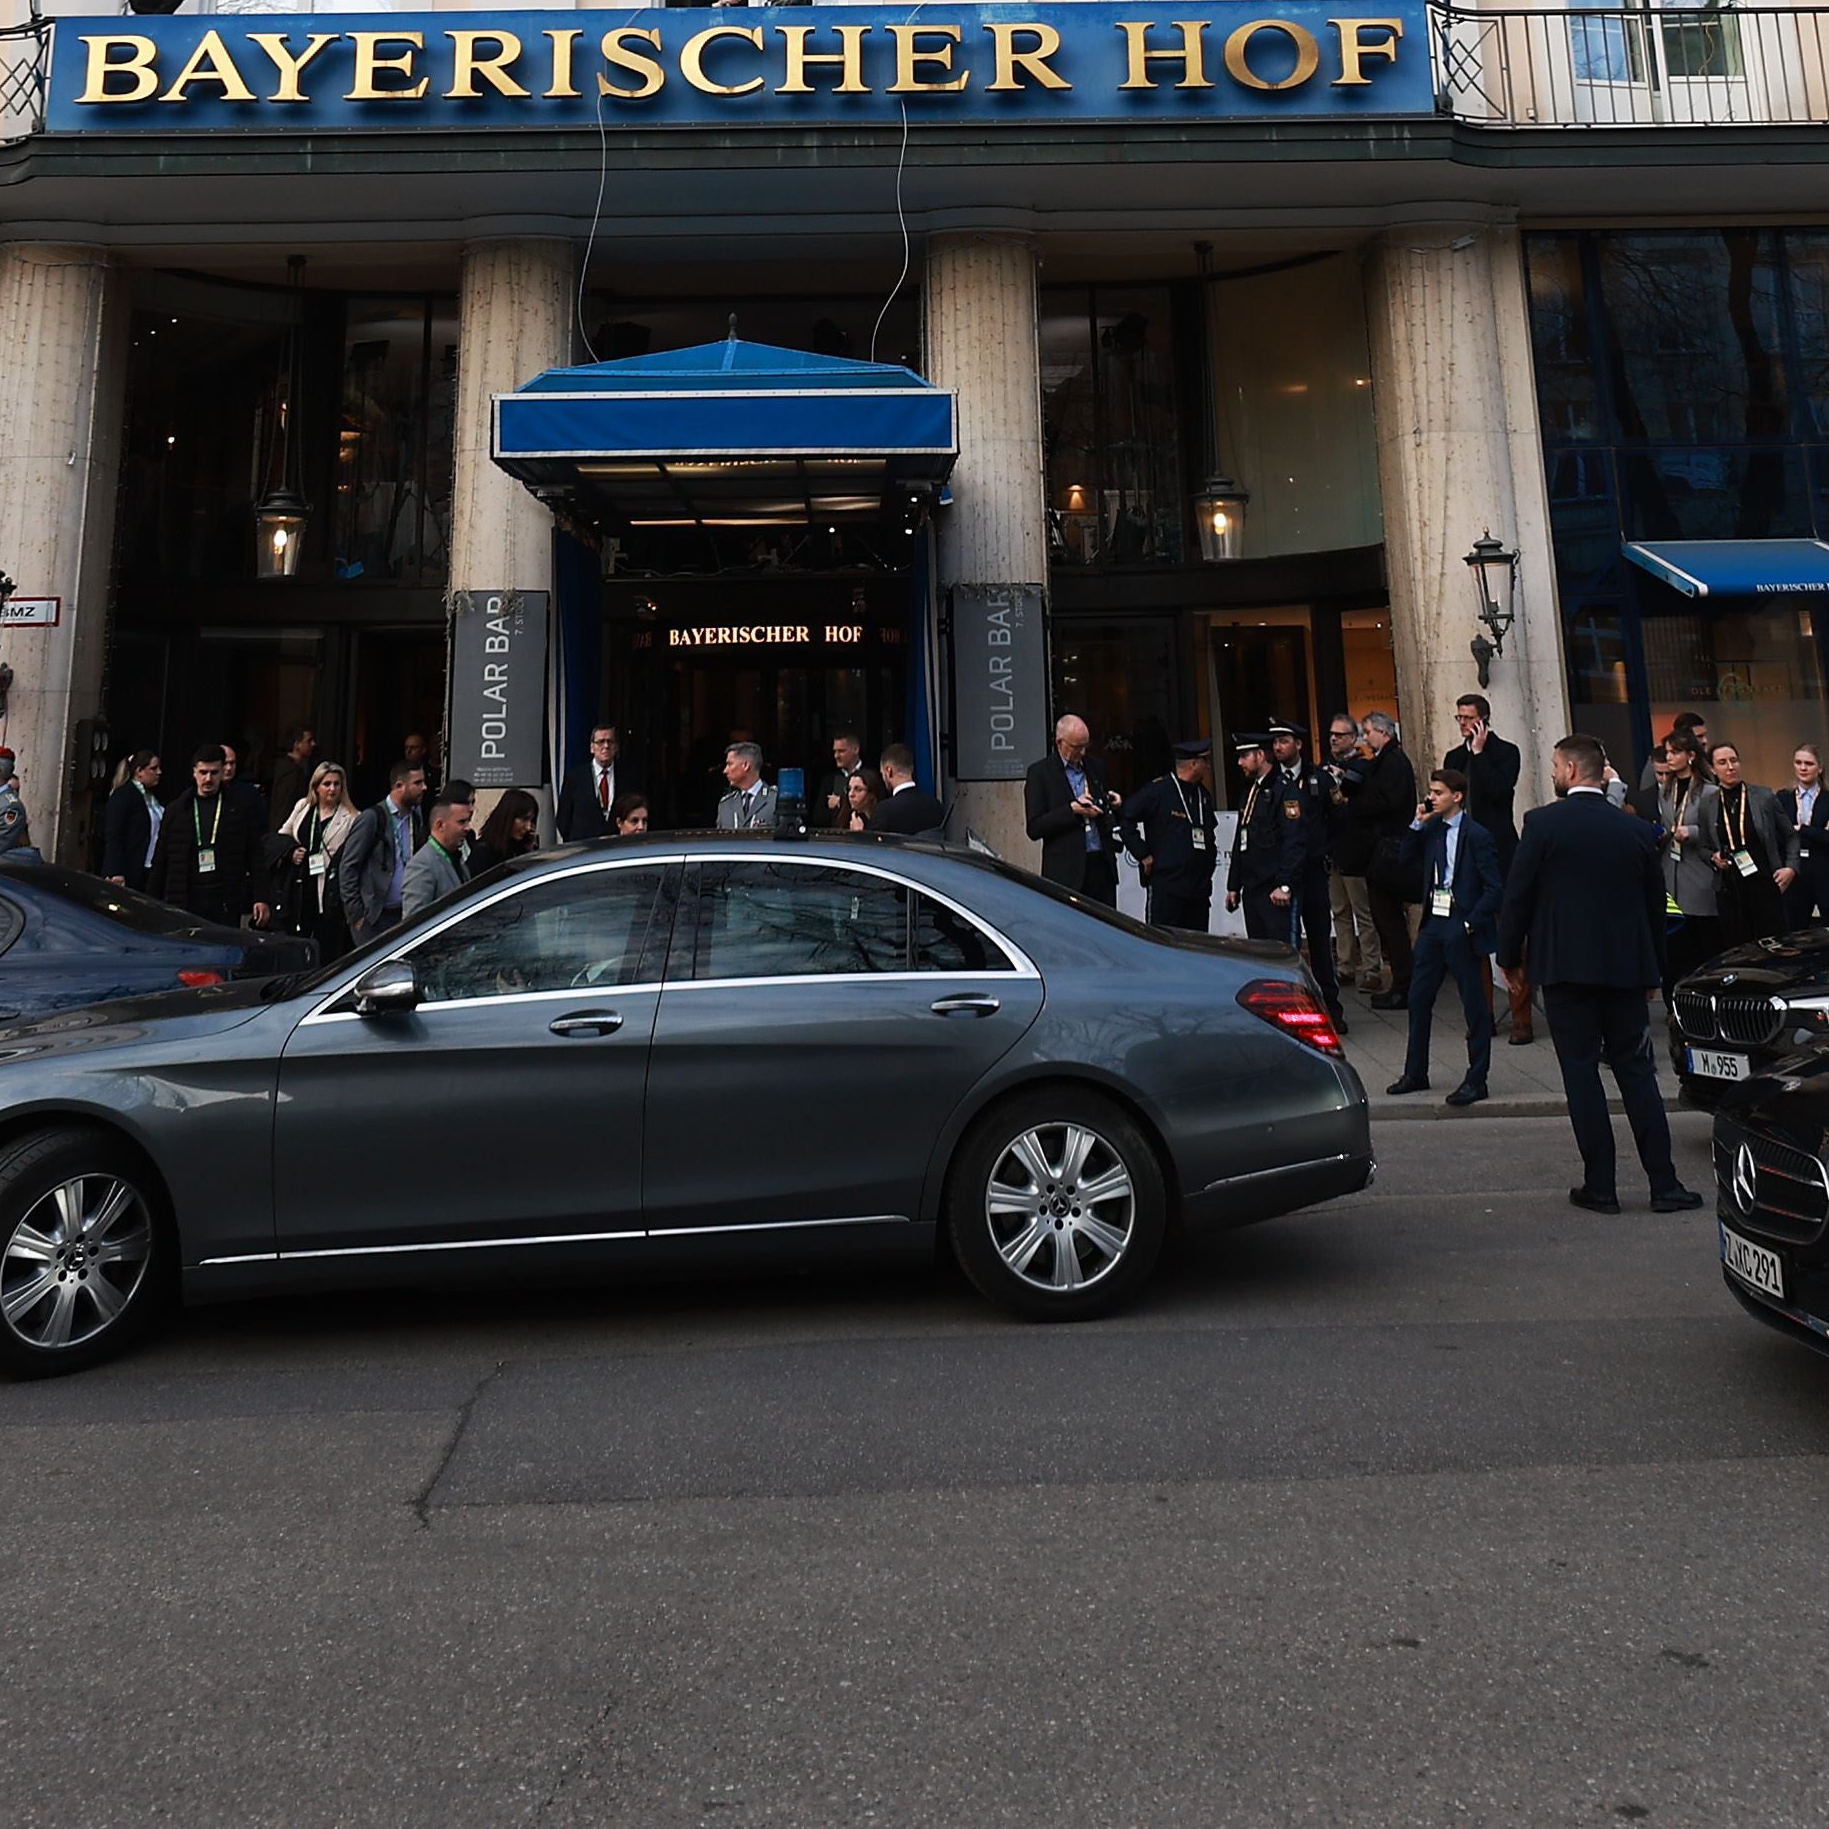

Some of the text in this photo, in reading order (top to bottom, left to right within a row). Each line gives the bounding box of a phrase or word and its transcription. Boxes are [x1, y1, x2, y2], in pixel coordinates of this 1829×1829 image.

[74, 18, 1405, 104] BAYERISCHER HOF
[1755, 582, 1825, 592] BAYERISCHER
[485, 596, 510, 653] BAR
[669, 625, 810, 646] BAYERISCHER
[824, 625, 862, 642] HOF
[987, 590, 1011, 646] BAR
[481, 663, 508, 759] POLAR
[989, 656, 1014, 750] POLAR
[1717, 1055, 1738, 1077] 955
[1753, 1249, 1781, 1292] 291
